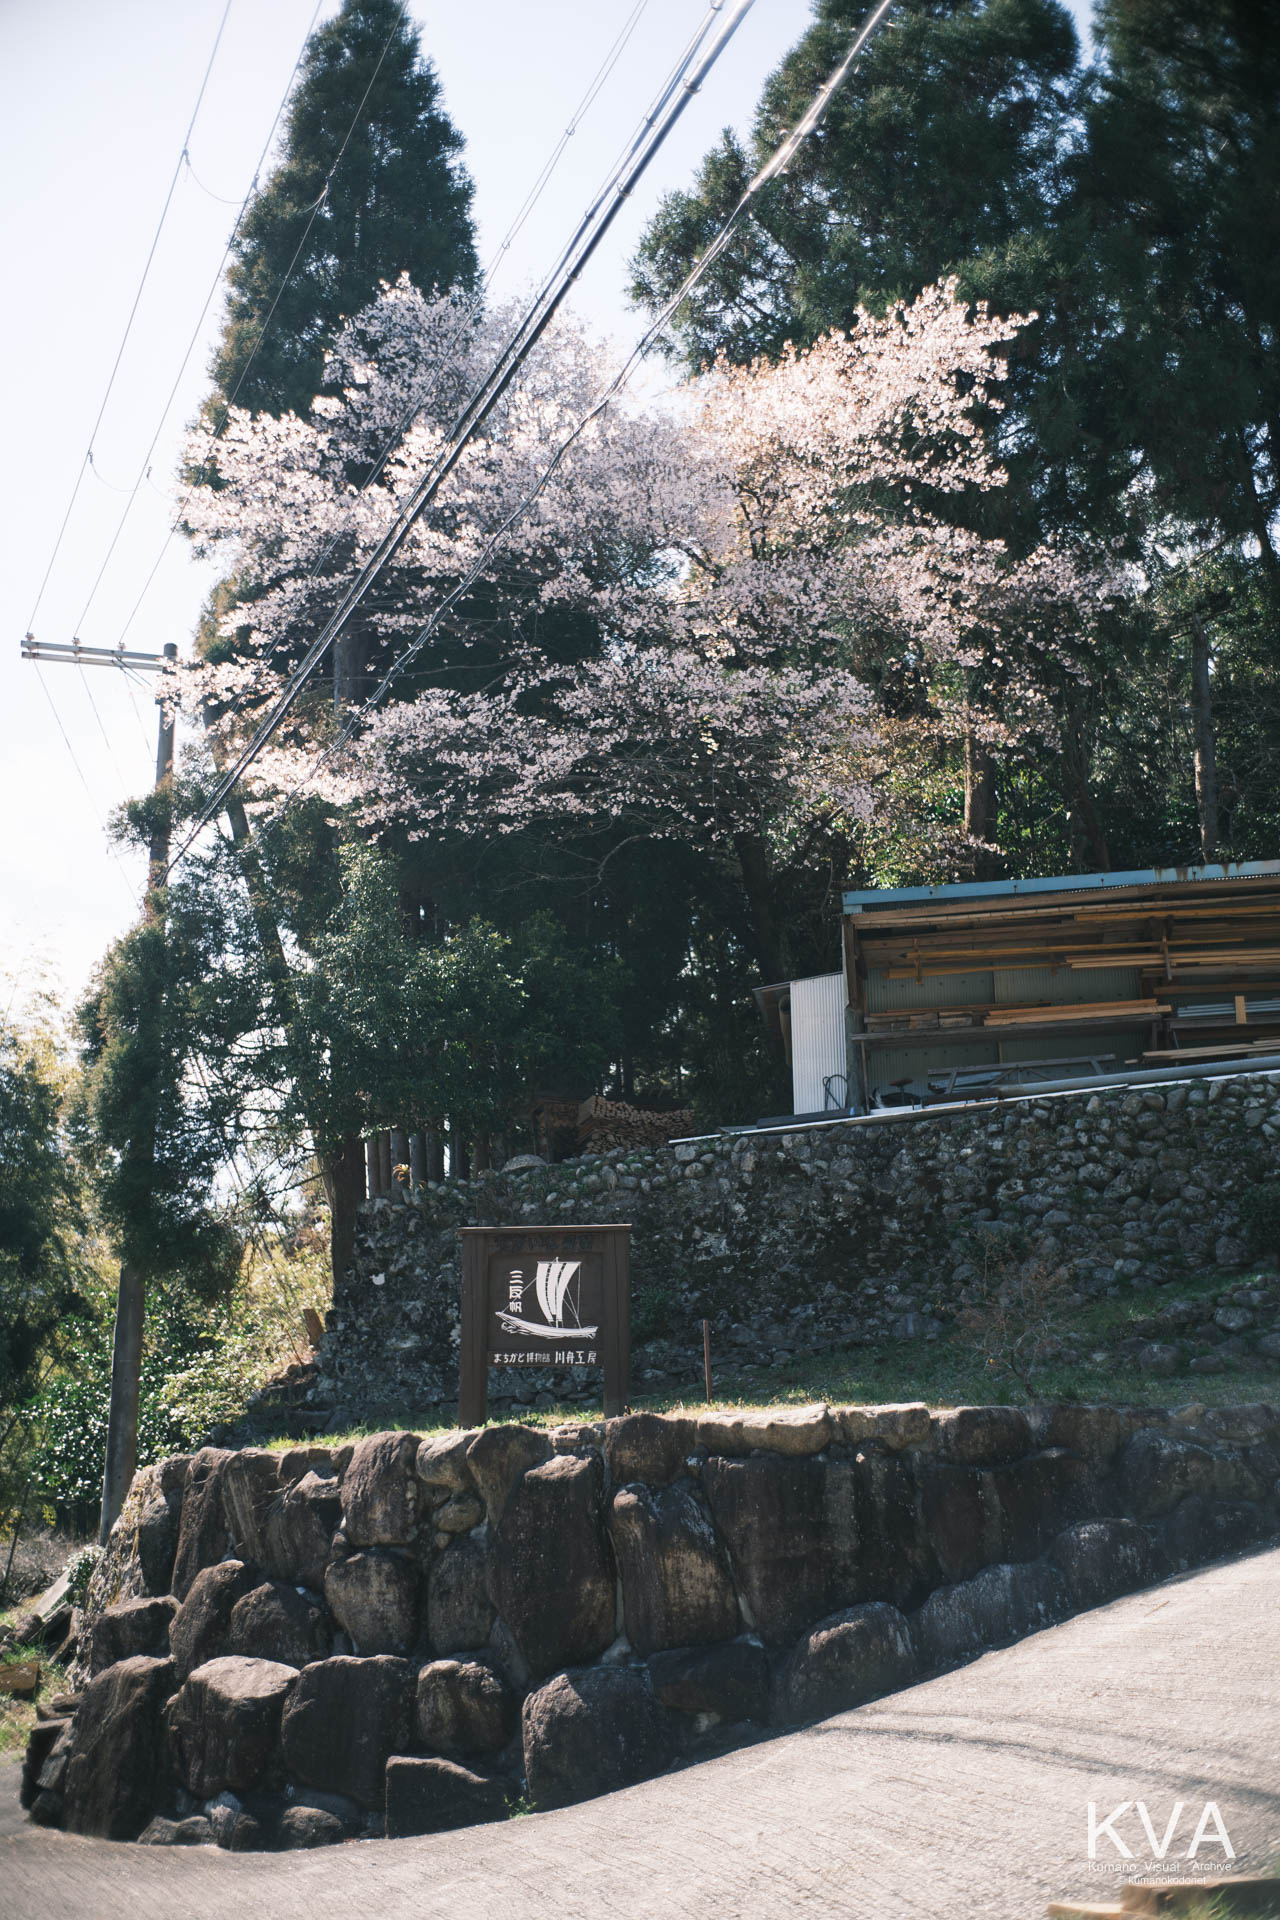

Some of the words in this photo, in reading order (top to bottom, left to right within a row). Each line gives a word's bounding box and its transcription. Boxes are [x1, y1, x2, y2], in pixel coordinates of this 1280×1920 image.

[509, 1270, 524, 1313] 三反帆
[555, 1350, 597, 1364] 川舟工房
